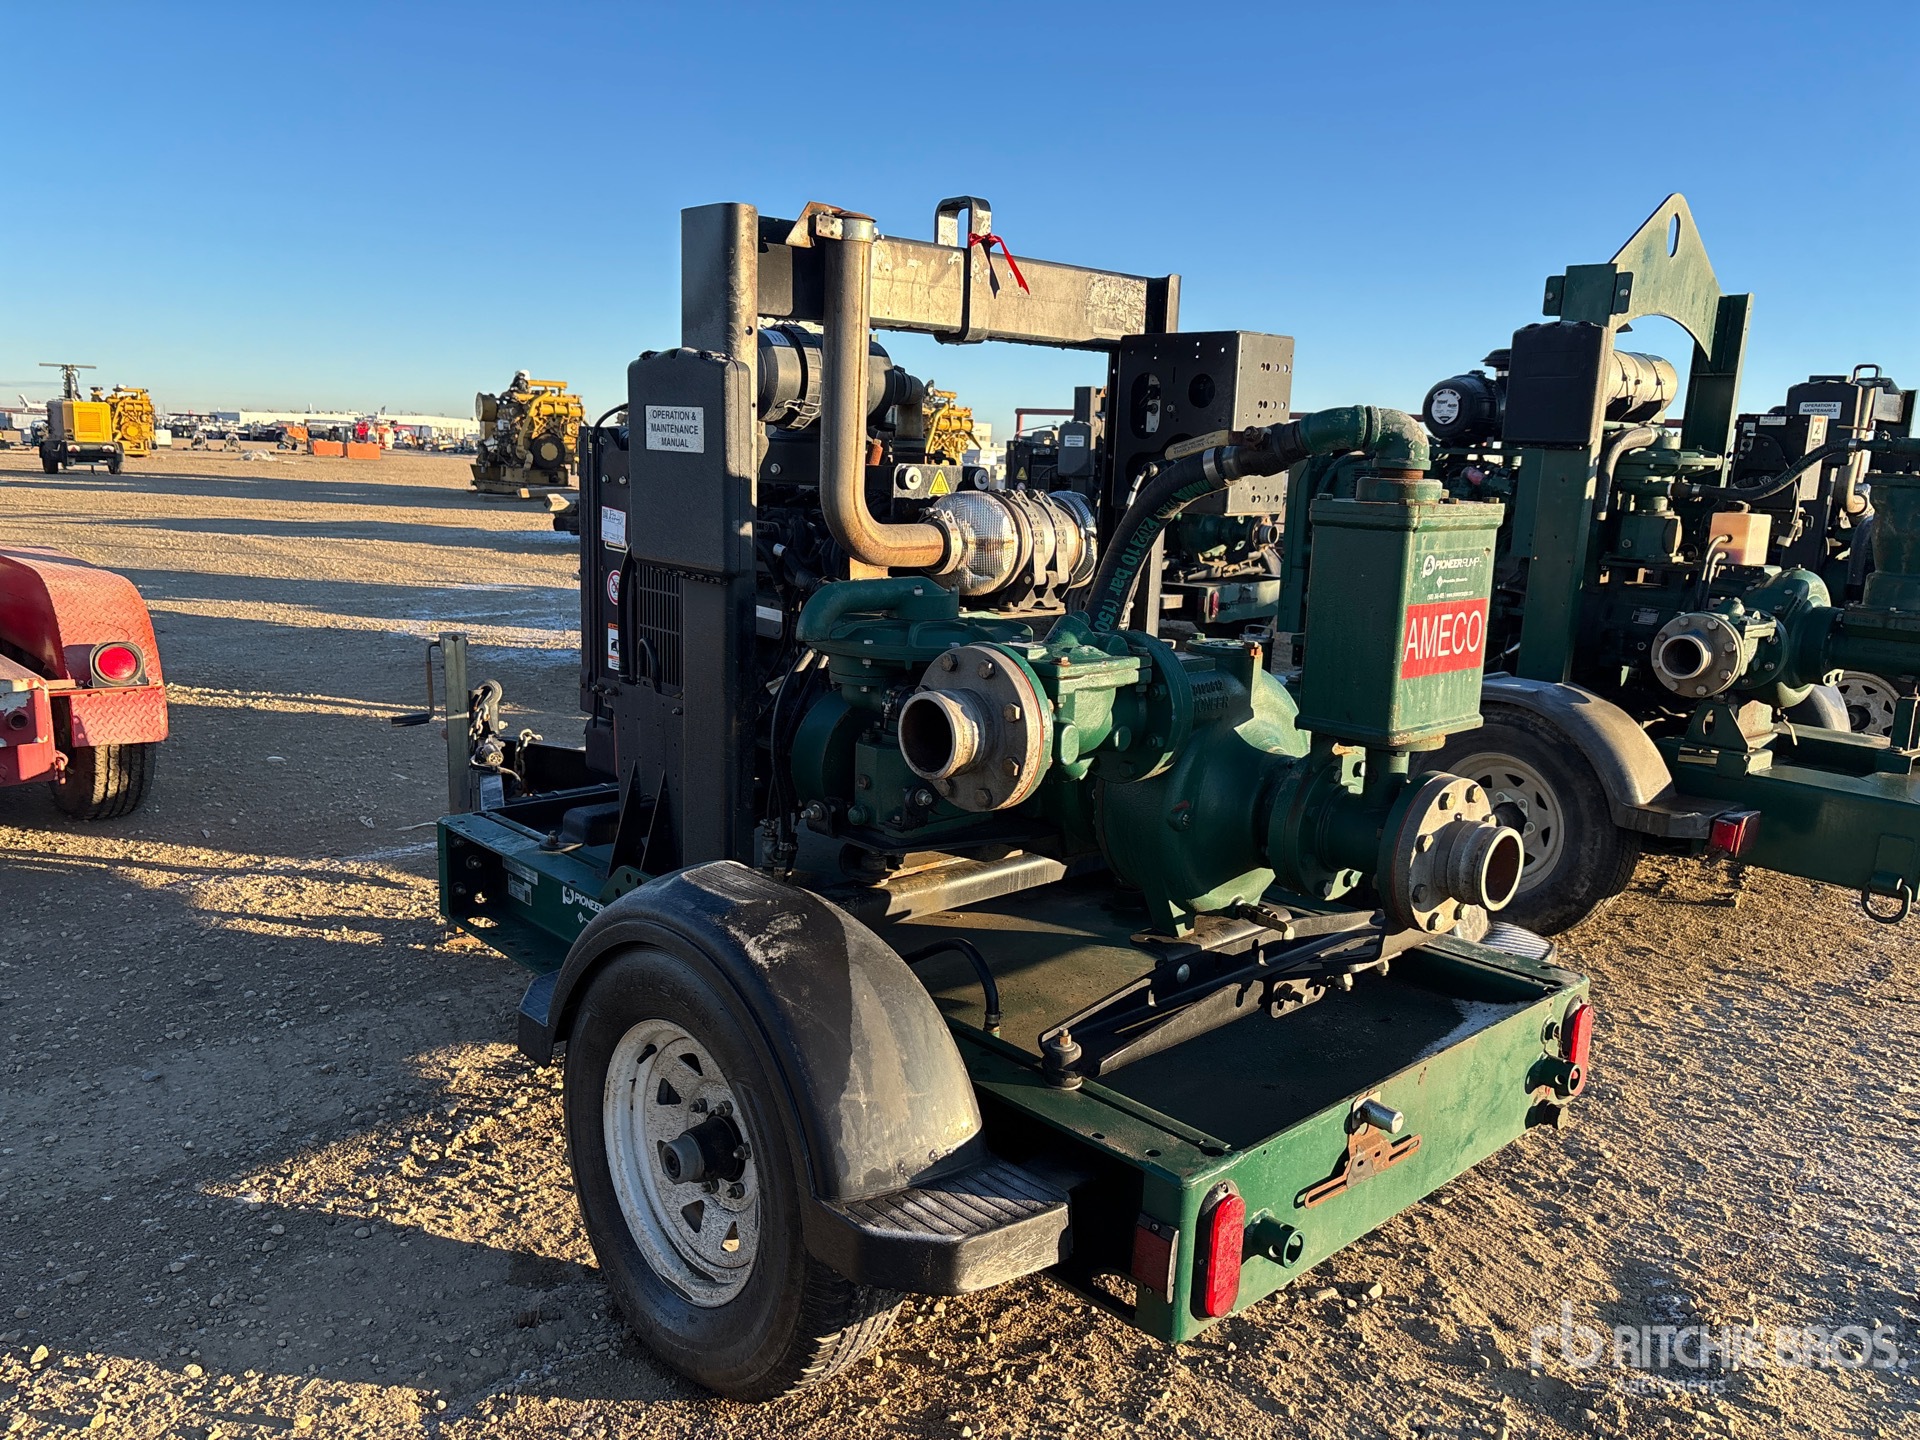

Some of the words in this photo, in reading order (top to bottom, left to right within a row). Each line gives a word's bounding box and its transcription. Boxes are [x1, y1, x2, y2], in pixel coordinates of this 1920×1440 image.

[652, 409, 690, 420] OPERATION
[691, 411, 697, 421] &
[650, 423, 699, 435] MAINTENANCE
[661, 437, 689, 448] MANUAL
[1121, 547, 1141, 566] 10
[1109, 567, 1134, 596] bar
[1094, 599, 1120, 632] (150
[1403, 610, 1482, 662] AMECO
